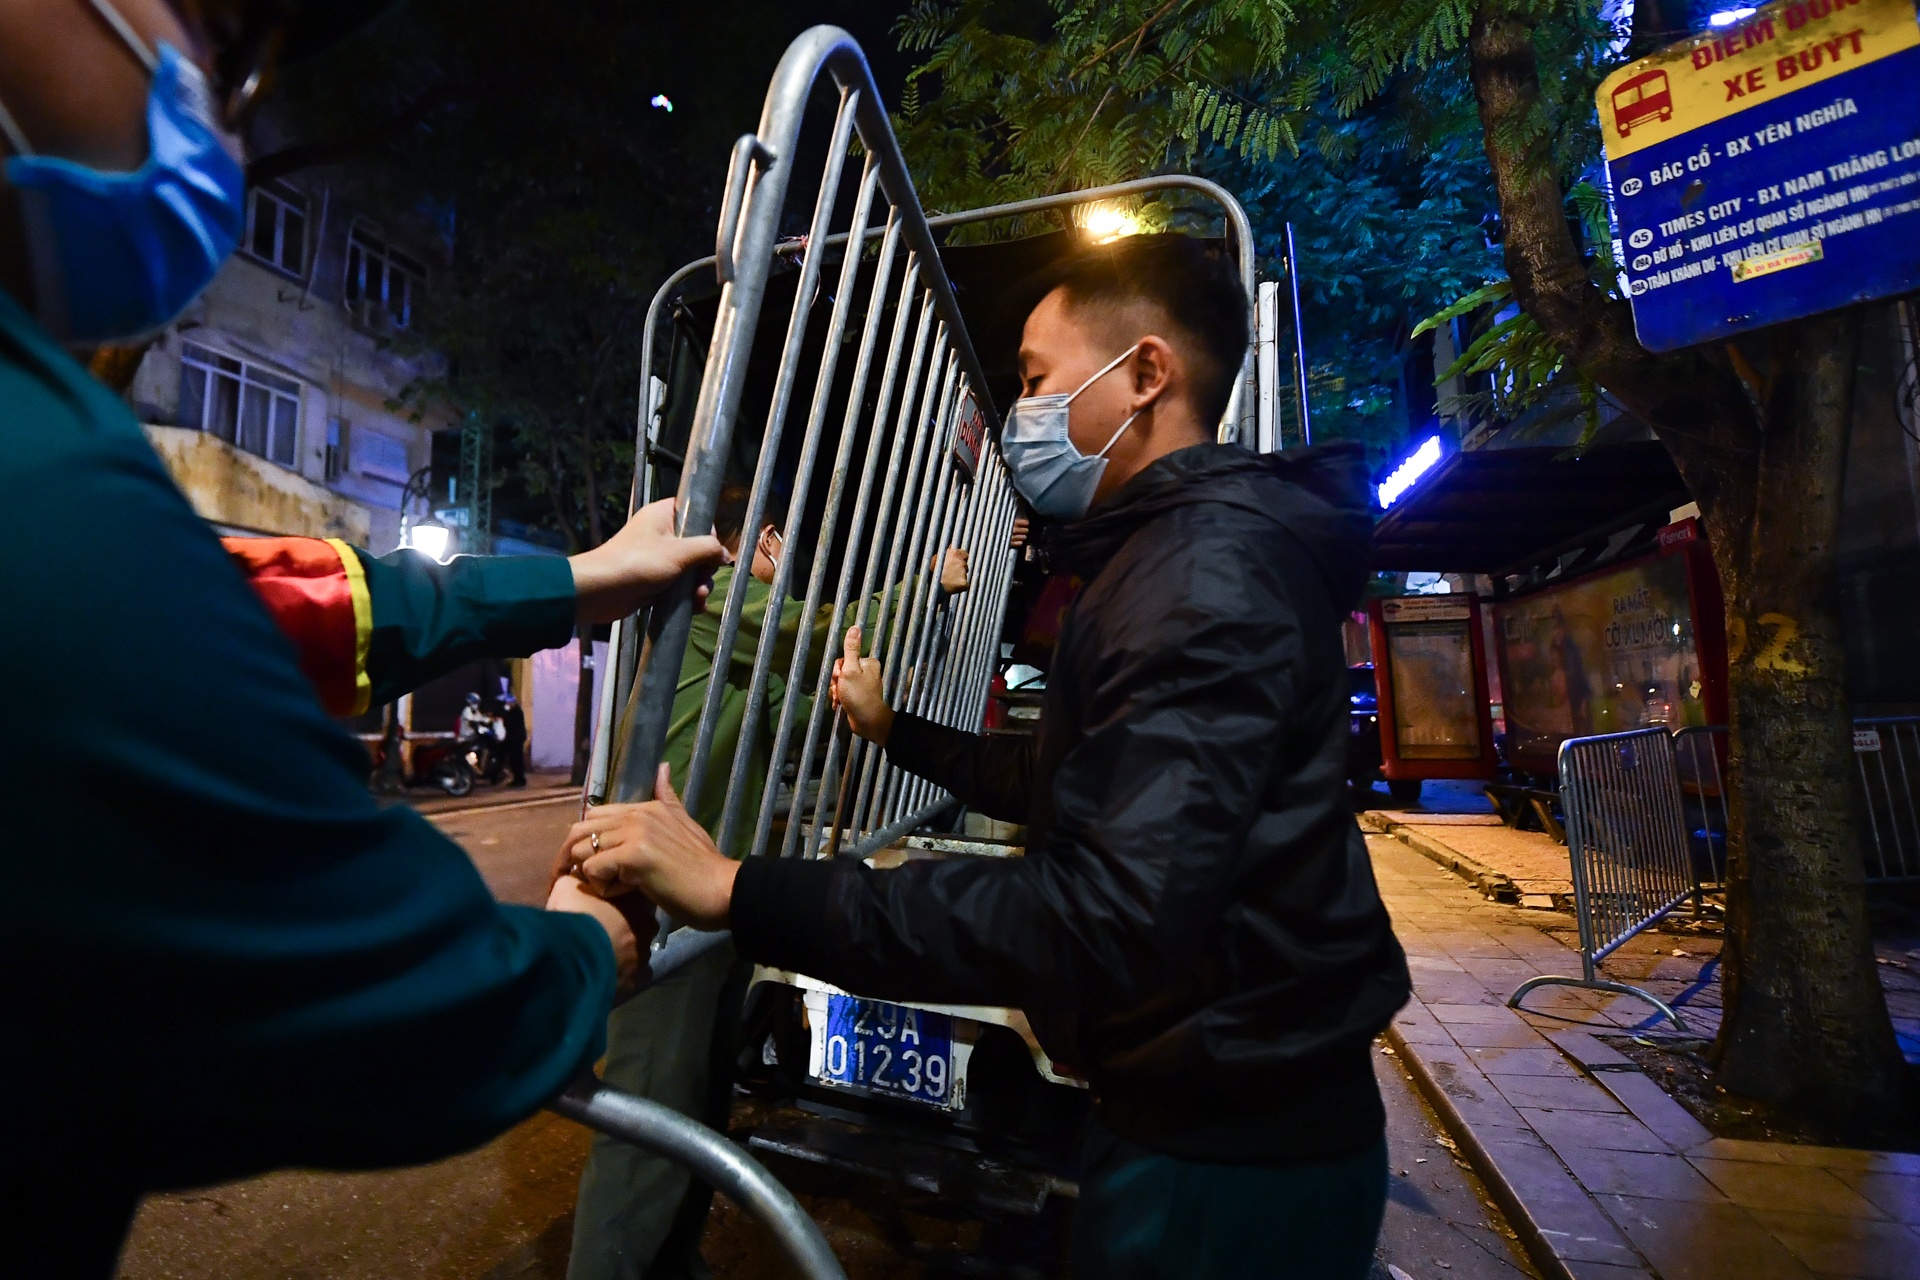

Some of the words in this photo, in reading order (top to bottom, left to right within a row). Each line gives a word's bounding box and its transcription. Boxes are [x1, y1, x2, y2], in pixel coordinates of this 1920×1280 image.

[1722, 66, 1766, 102] XE
[1623, 180, 1640, 194] 02
[1687, 144, 1711, 172] CỔ
[1726, 135, 1752, 158] BX
[1754, 121, 1793, 147] YÊN
[1796, 97, 1859, 133] NGHĨA
[1633, 231, 1649, 243] 45
[1658, 210, 1706, 237] TIMES
[1708, 197, 1742, 221] CITY
[1757, 185, 1782, 205] BX
[1783, 170, 1826, 197] NAM
[1827, 150, 1889, 182] THĂNG
[1690, 233, 1713, 252] KHU
[1755, 210, 1788, 232] QUAN
[853, 999, 920, 1046] 29A
[827, 1035, 947, 1098] 012.39
